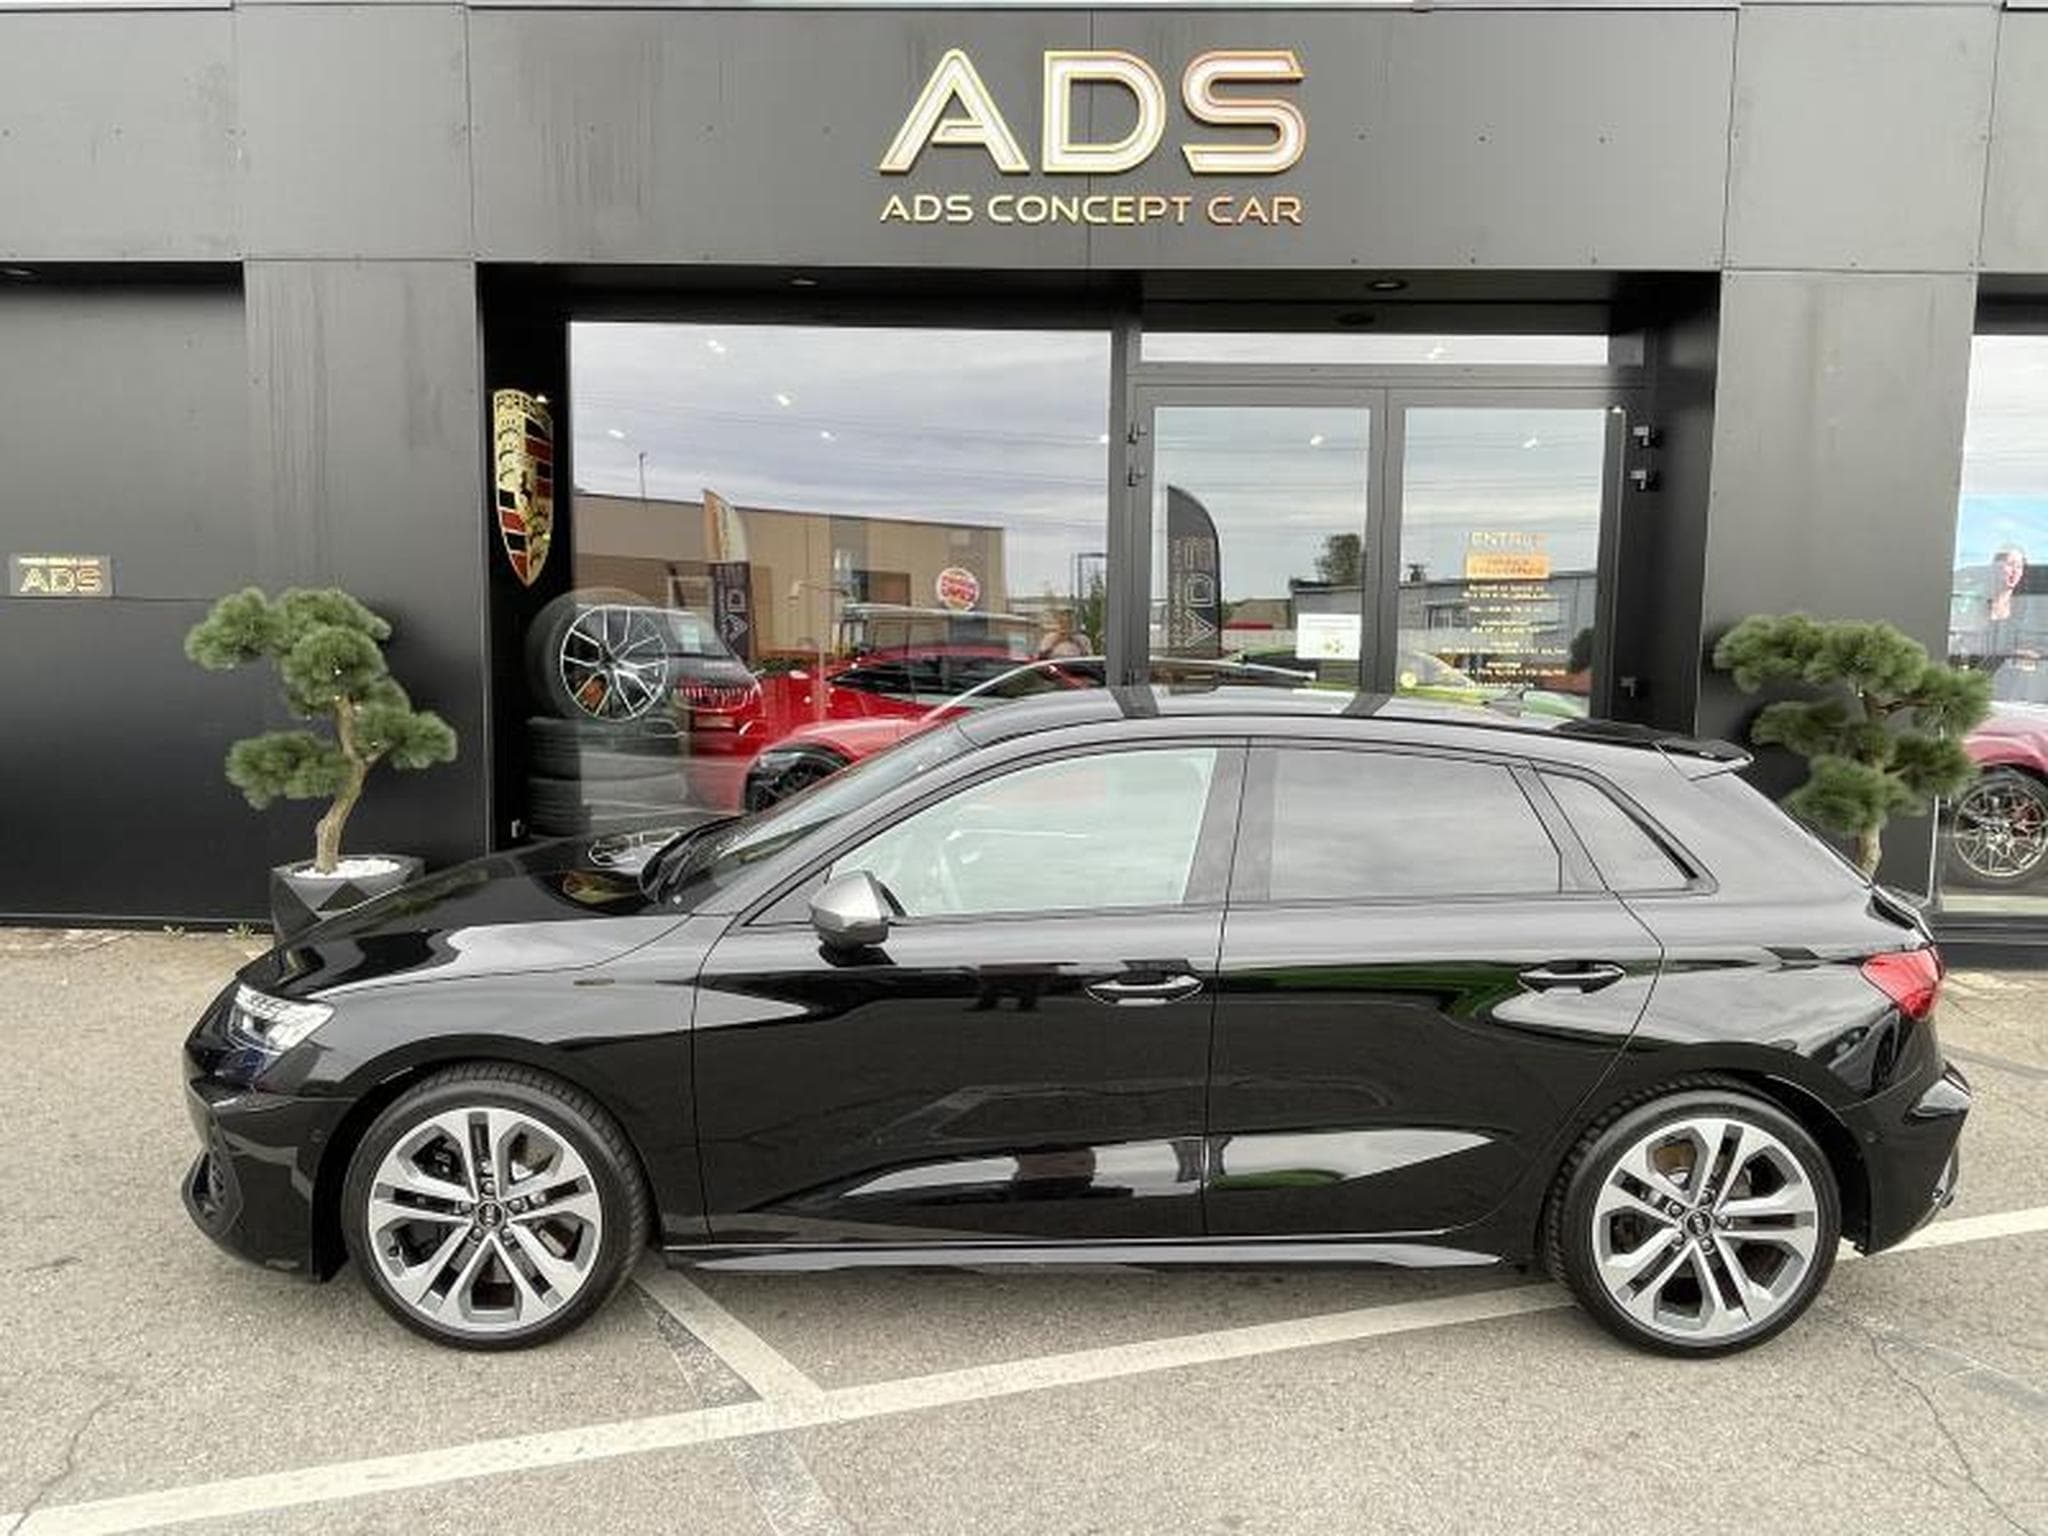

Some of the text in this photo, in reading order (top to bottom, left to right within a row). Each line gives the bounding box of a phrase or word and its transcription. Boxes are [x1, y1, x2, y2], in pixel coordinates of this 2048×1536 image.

[879, 48, 1307, 174] ADS
[880, 194, 1303, 224] ADS CONCEPT CAR
[20, 567, 102, 593] ADS
